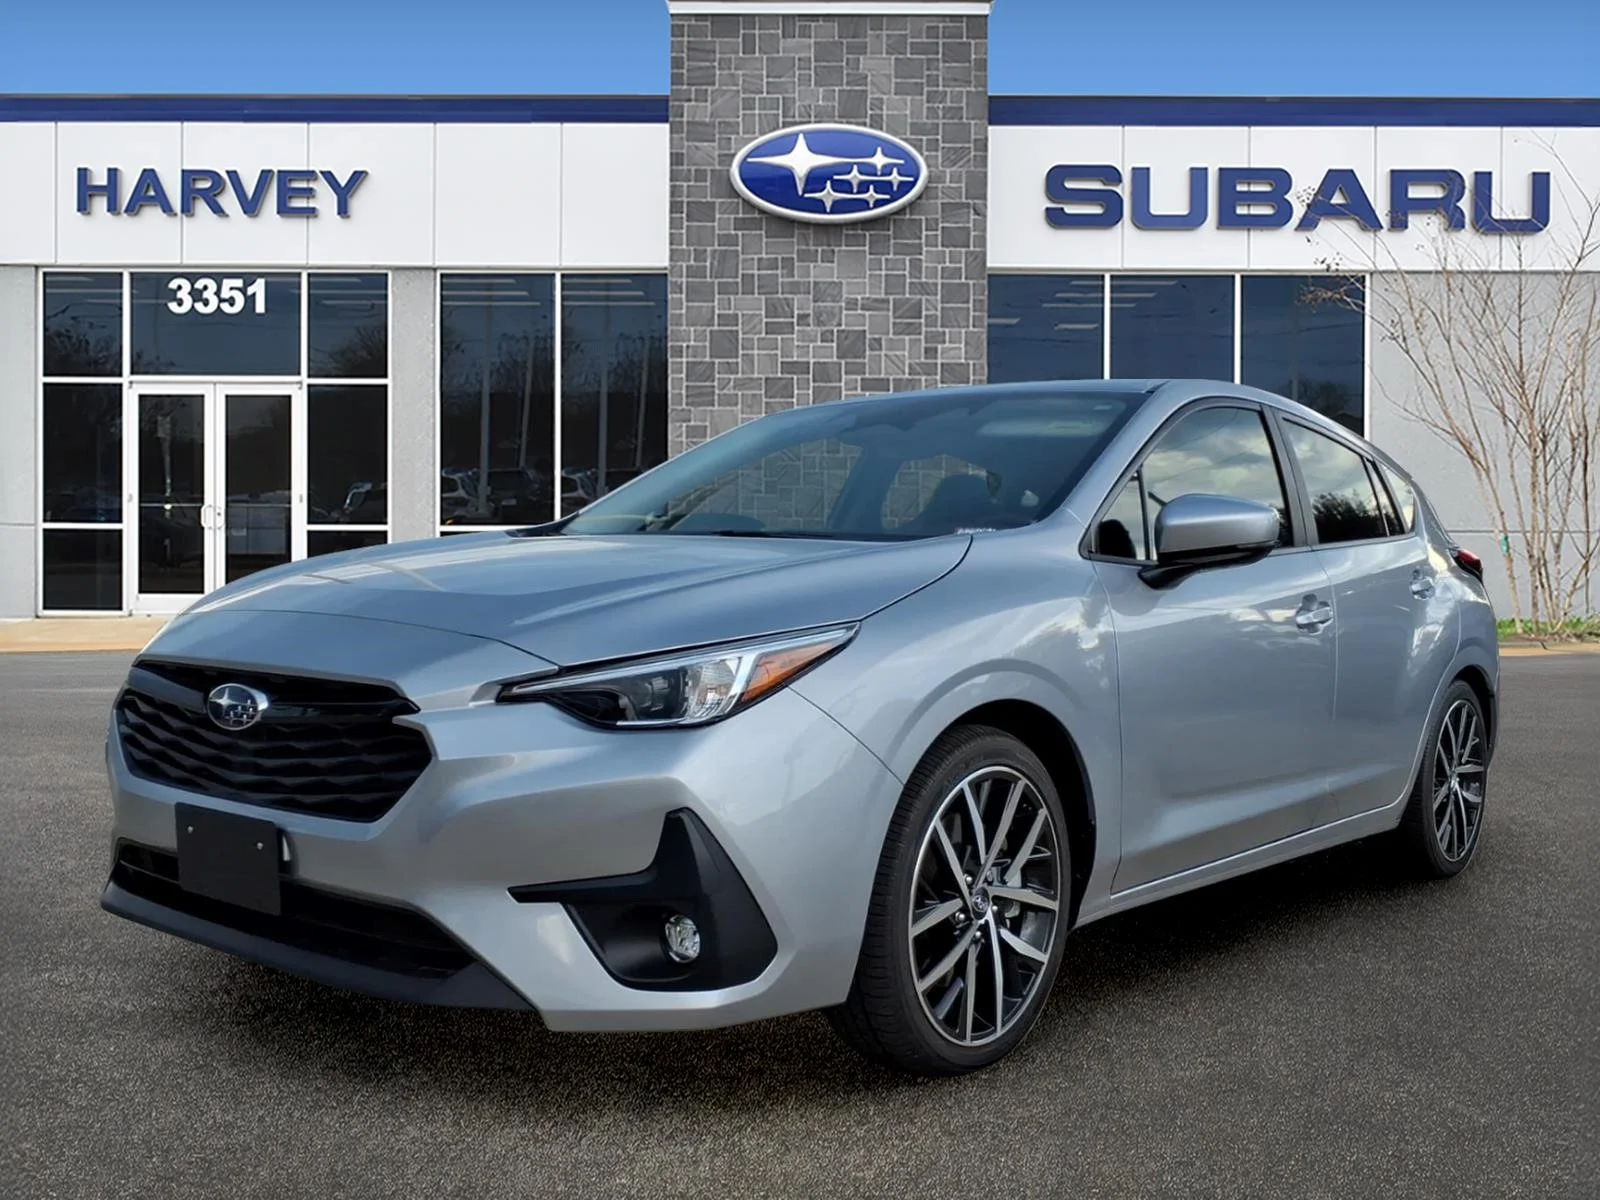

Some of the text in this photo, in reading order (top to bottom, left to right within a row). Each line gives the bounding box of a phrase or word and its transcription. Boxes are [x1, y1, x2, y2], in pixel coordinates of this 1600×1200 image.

[76, 166, 367, 217] HARVEY
[1045, 164, 1550, 233] SUBARU
[167, 278, 266, 314] 3351
